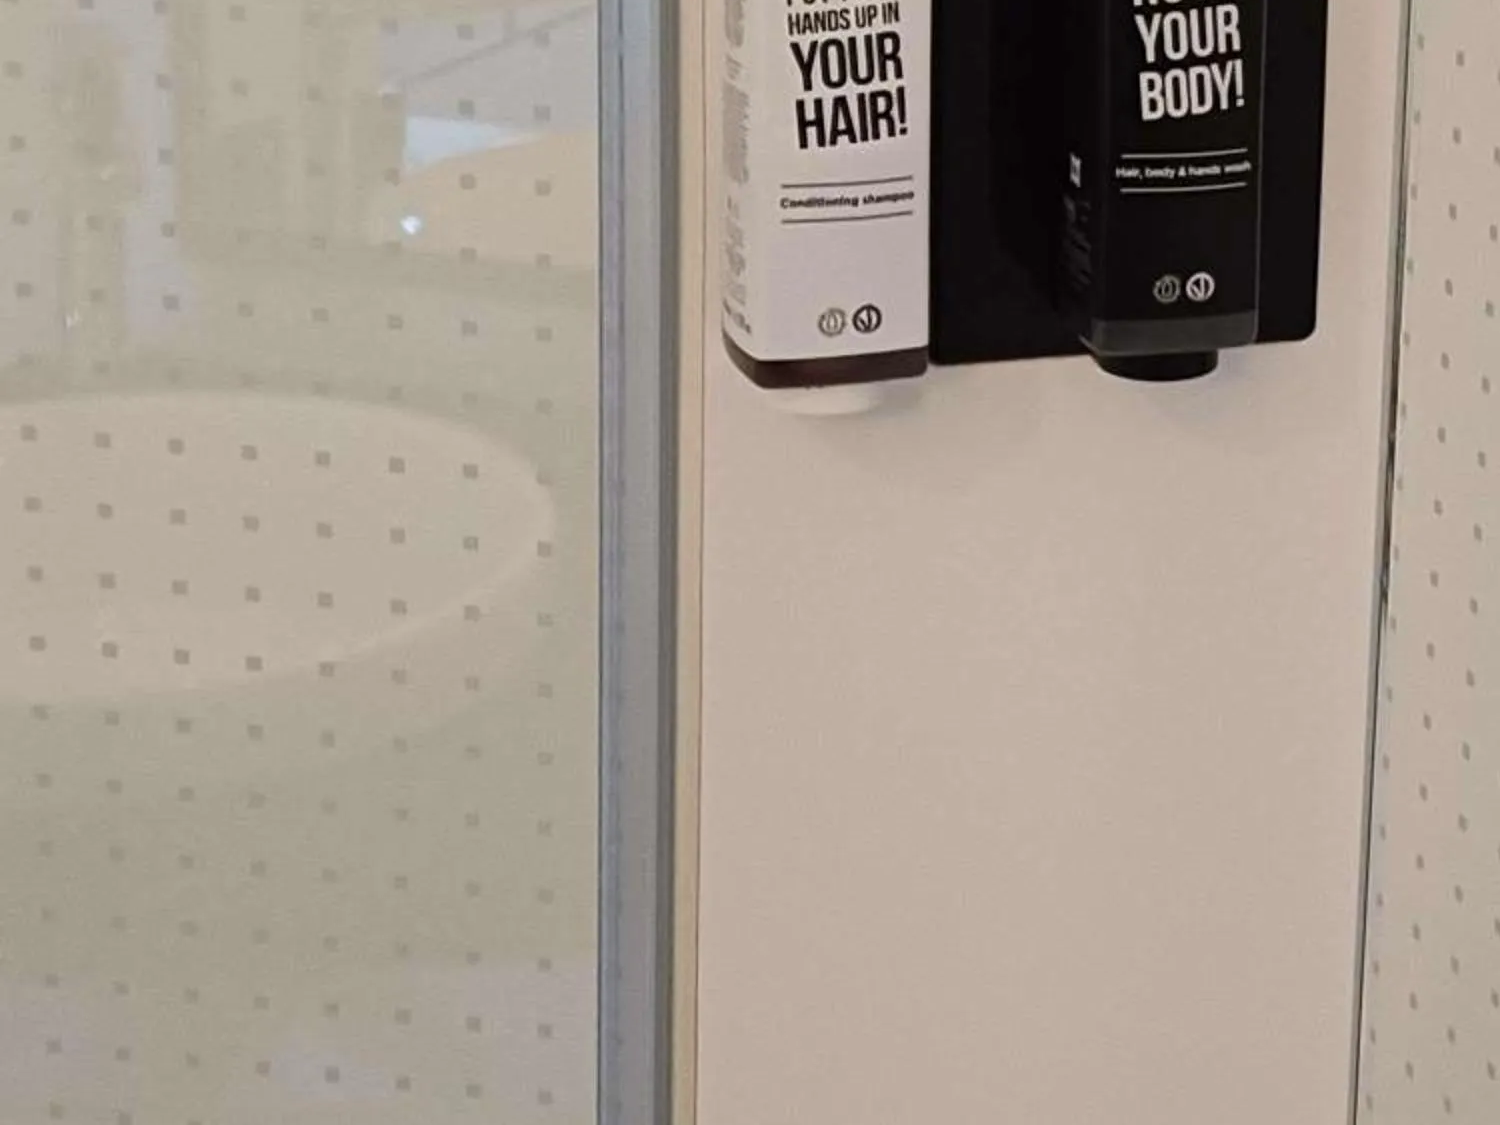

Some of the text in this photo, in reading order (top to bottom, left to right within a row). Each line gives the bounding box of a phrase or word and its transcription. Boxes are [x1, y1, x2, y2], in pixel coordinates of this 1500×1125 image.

[787, 1, 900, 36] HANDS UP IN
[1134, 4, 1241, 63] YOUR
[789, 31, 903, 92] YOUR
[1139, 58, 1245, 122] BODY!
[796, 86, 908, 150] HAIR!
[1115, 159, 1252, 180] Hair, body & hands wash
[780, 190, 915, 209] Conditioning shampoo
